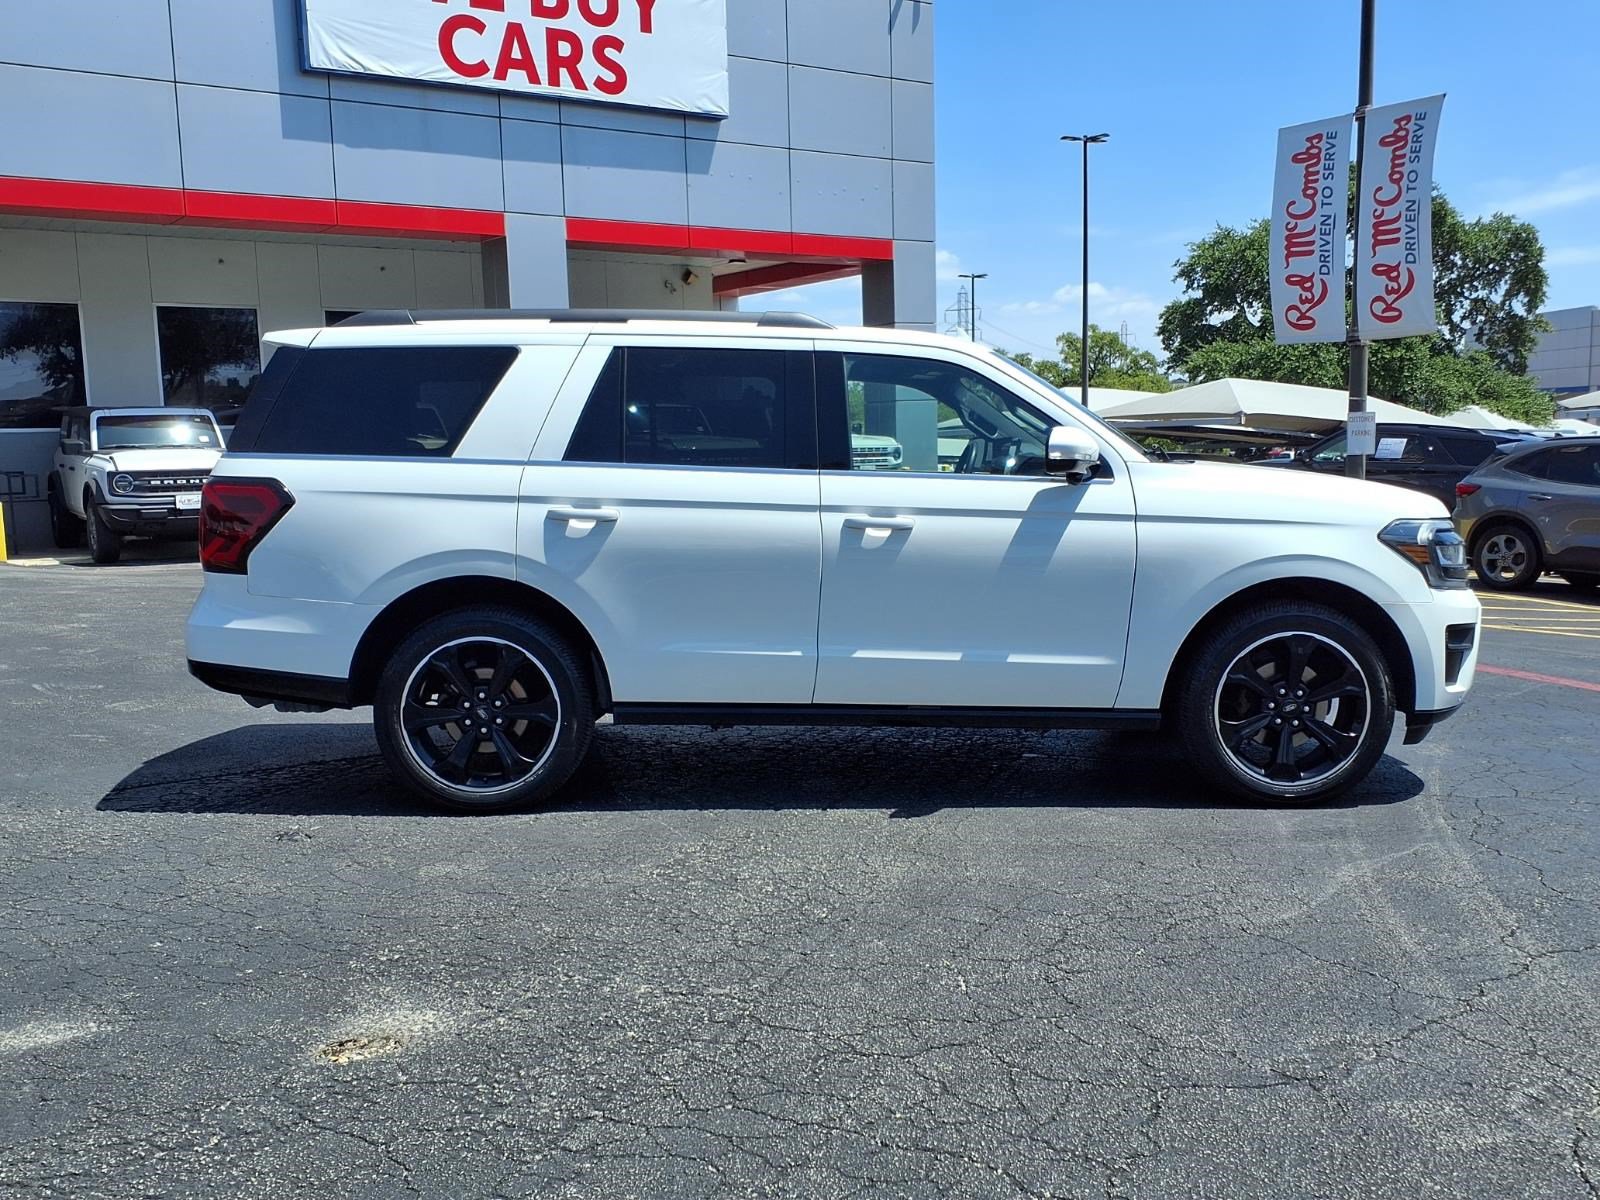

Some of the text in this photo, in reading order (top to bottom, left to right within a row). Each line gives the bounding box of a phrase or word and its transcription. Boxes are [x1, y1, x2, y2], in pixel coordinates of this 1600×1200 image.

[437, 13, 628, 96] CARS
[1284, 132, 1329, 331] Red McCombs
[1318, 130, 1338, 276] DRIVEN TO SERVE
[1369, 113, 1415, 324] Red McCombs
[1405, 111, 1427, 265] DRIVEN TO SERVE
